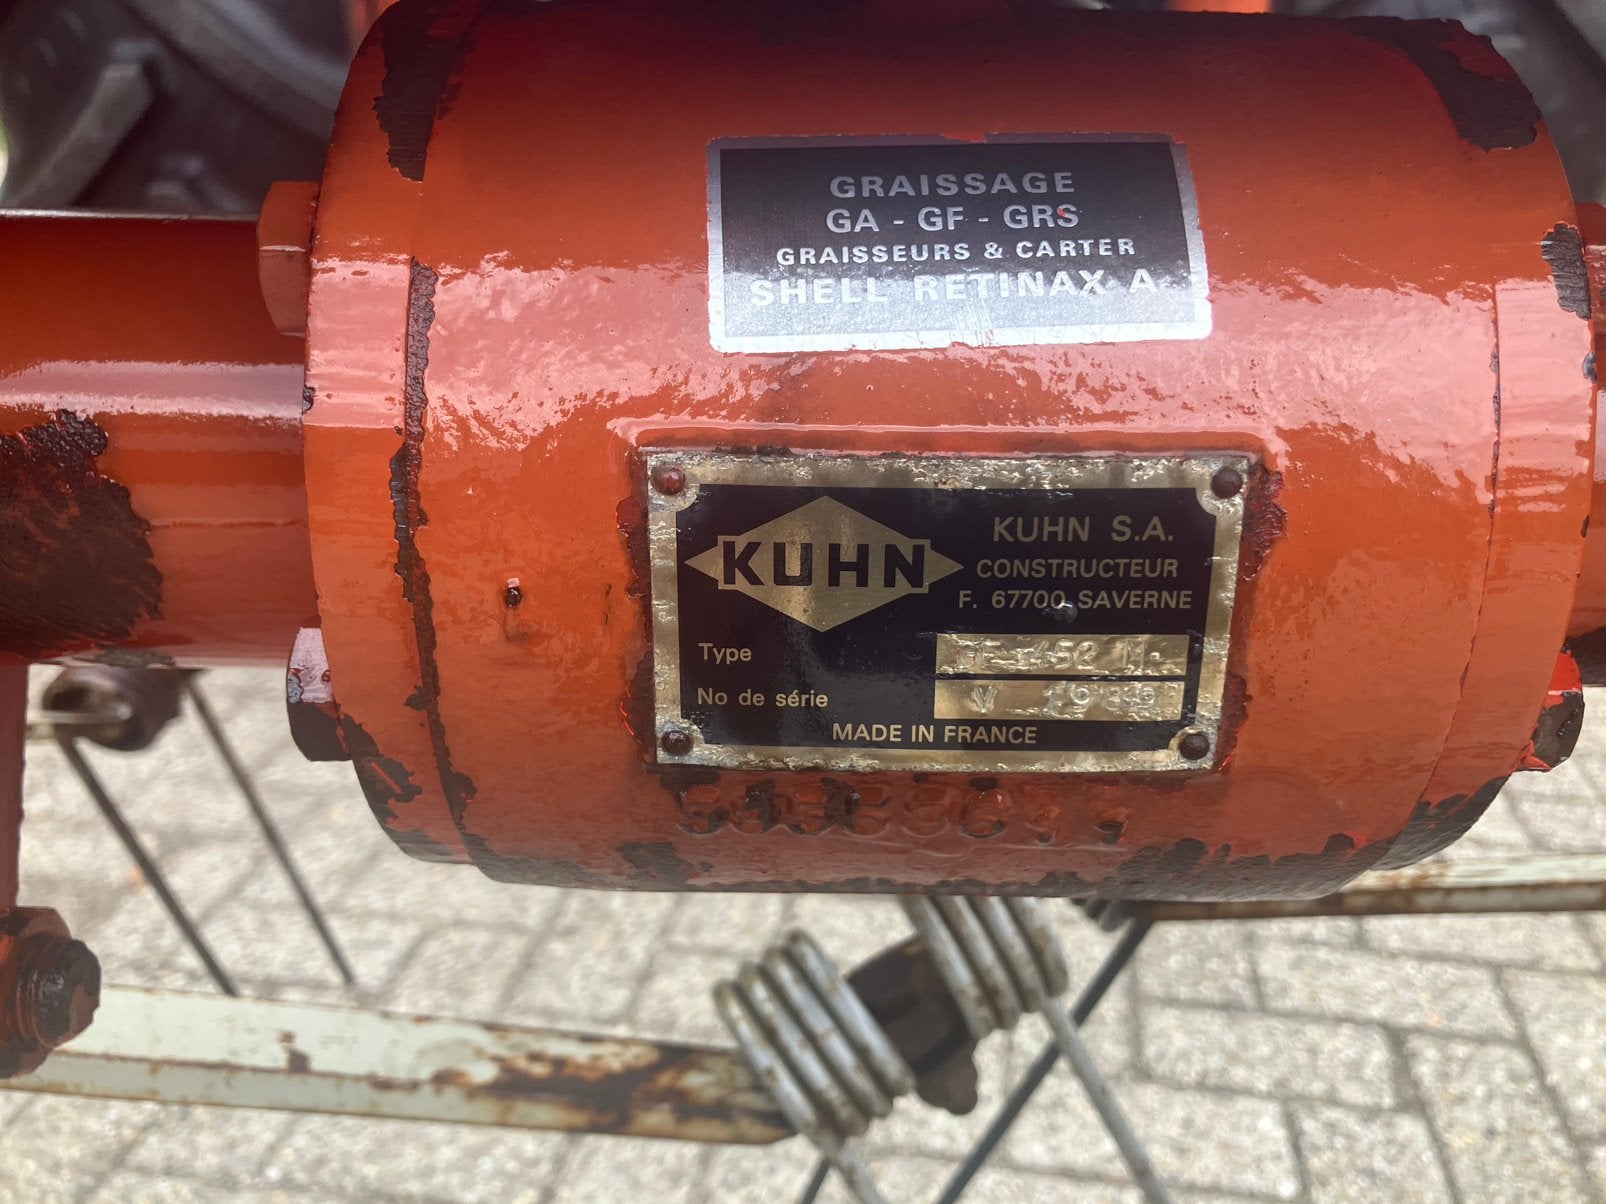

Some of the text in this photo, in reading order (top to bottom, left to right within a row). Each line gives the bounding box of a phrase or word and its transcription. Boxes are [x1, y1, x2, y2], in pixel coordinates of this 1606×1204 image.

[829, 171, 1076, 199] GRAISSAGE
[826, 207, 880, 234] GA
[917, 206, 966, 231] GF
[1003, 203, 1080, 229] GRS
[776, 238, 1137, 267] GRAISSEURS & CARTER
[750, 267, 1159, 306] SHELL RETINAX A
[992, 515, 1175, 543] KUHN S.A.
[723, 540, 925, 588] KUHN
[975, 558, 1179, 579] CONSTRUCTEUR
[958, 590, 1193, 609] F. 67700 SAVERNE
[697, 642, 752, 665] Type
[697, 687, 829, 709] No de série
[831, 722, 1038, 744] MADE IN FRANCE
